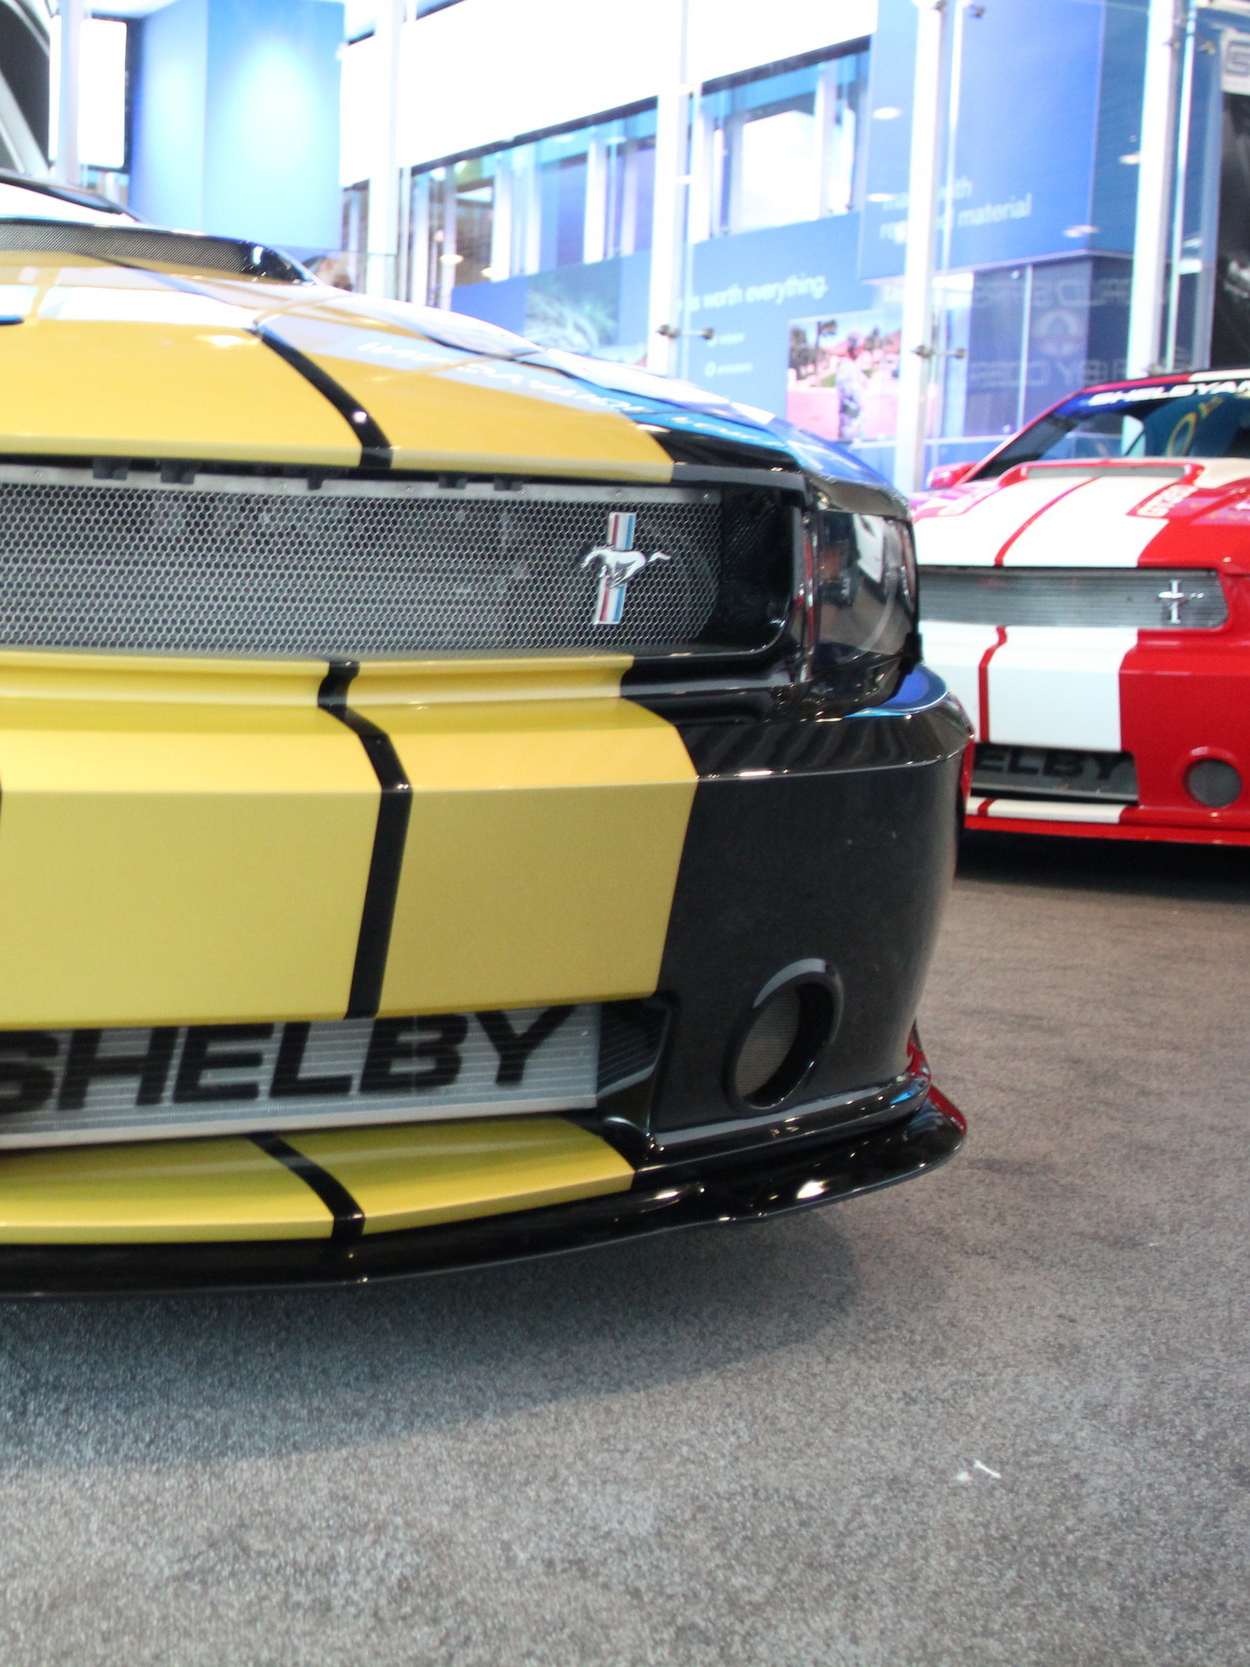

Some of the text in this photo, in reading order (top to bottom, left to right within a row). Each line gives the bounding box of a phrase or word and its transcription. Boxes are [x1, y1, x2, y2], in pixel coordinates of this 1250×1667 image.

[957, 192, 1032, 228] material
[703, 284, 743, 309] worth
[974, 745, 1135, 780] ELBY
